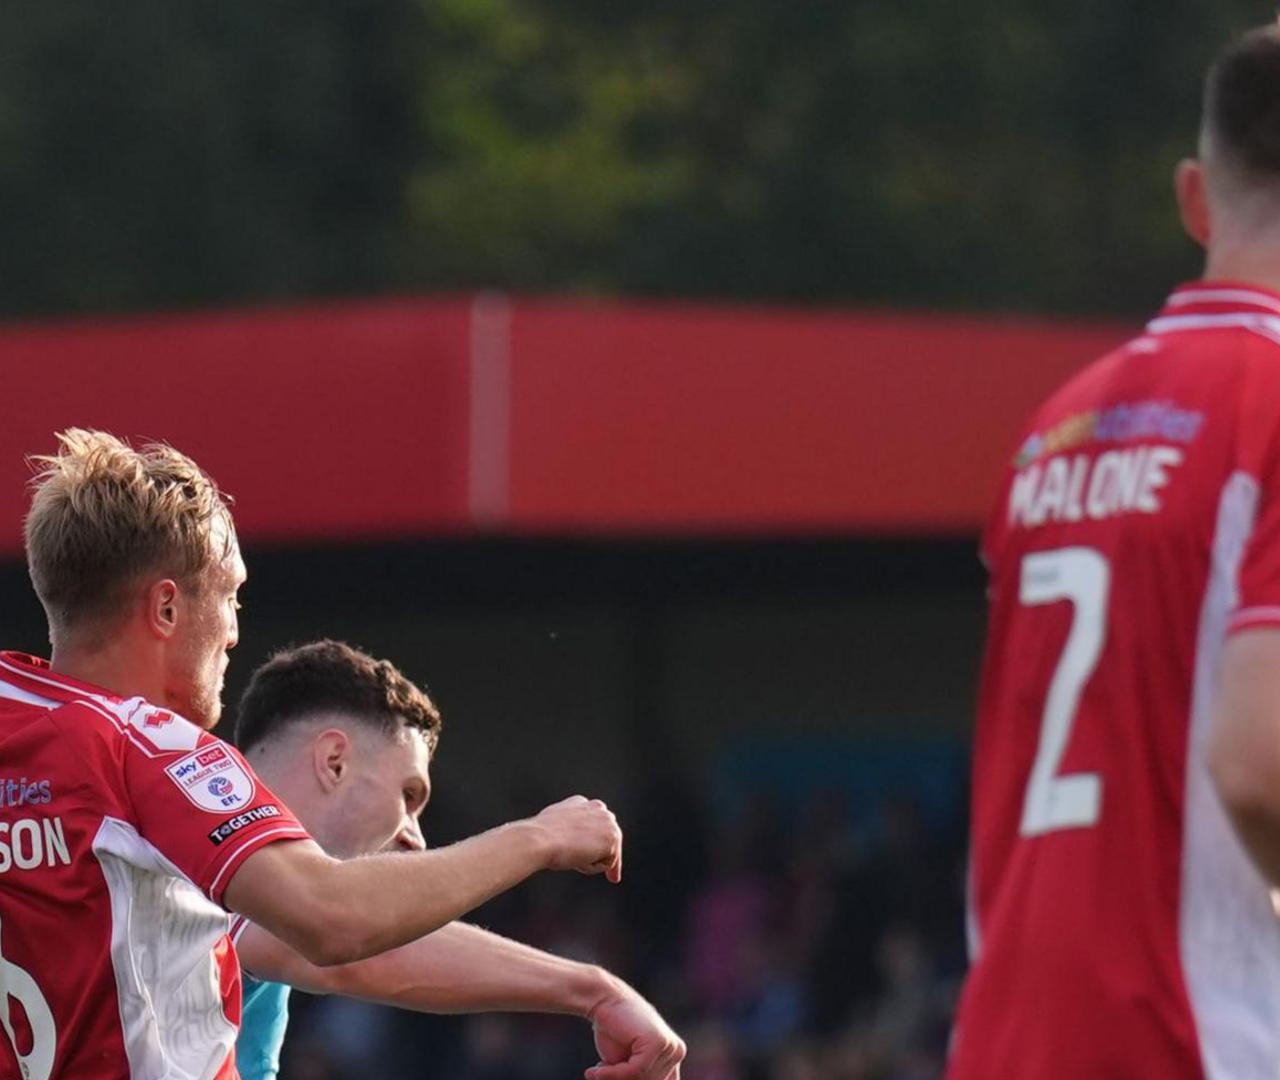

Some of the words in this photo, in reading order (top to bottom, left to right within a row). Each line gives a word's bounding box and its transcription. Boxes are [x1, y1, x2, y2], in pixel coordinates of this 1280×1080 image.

[1009, 446, 1183, 527] MALONE
[1020, 546, 1110, 838] 2
[175, 761, 197, 778] sky
[199, 747, 224, 766] bet
[183, 767, 213, 787] LEAGUE
[221, 794, 242, 807] EFL
